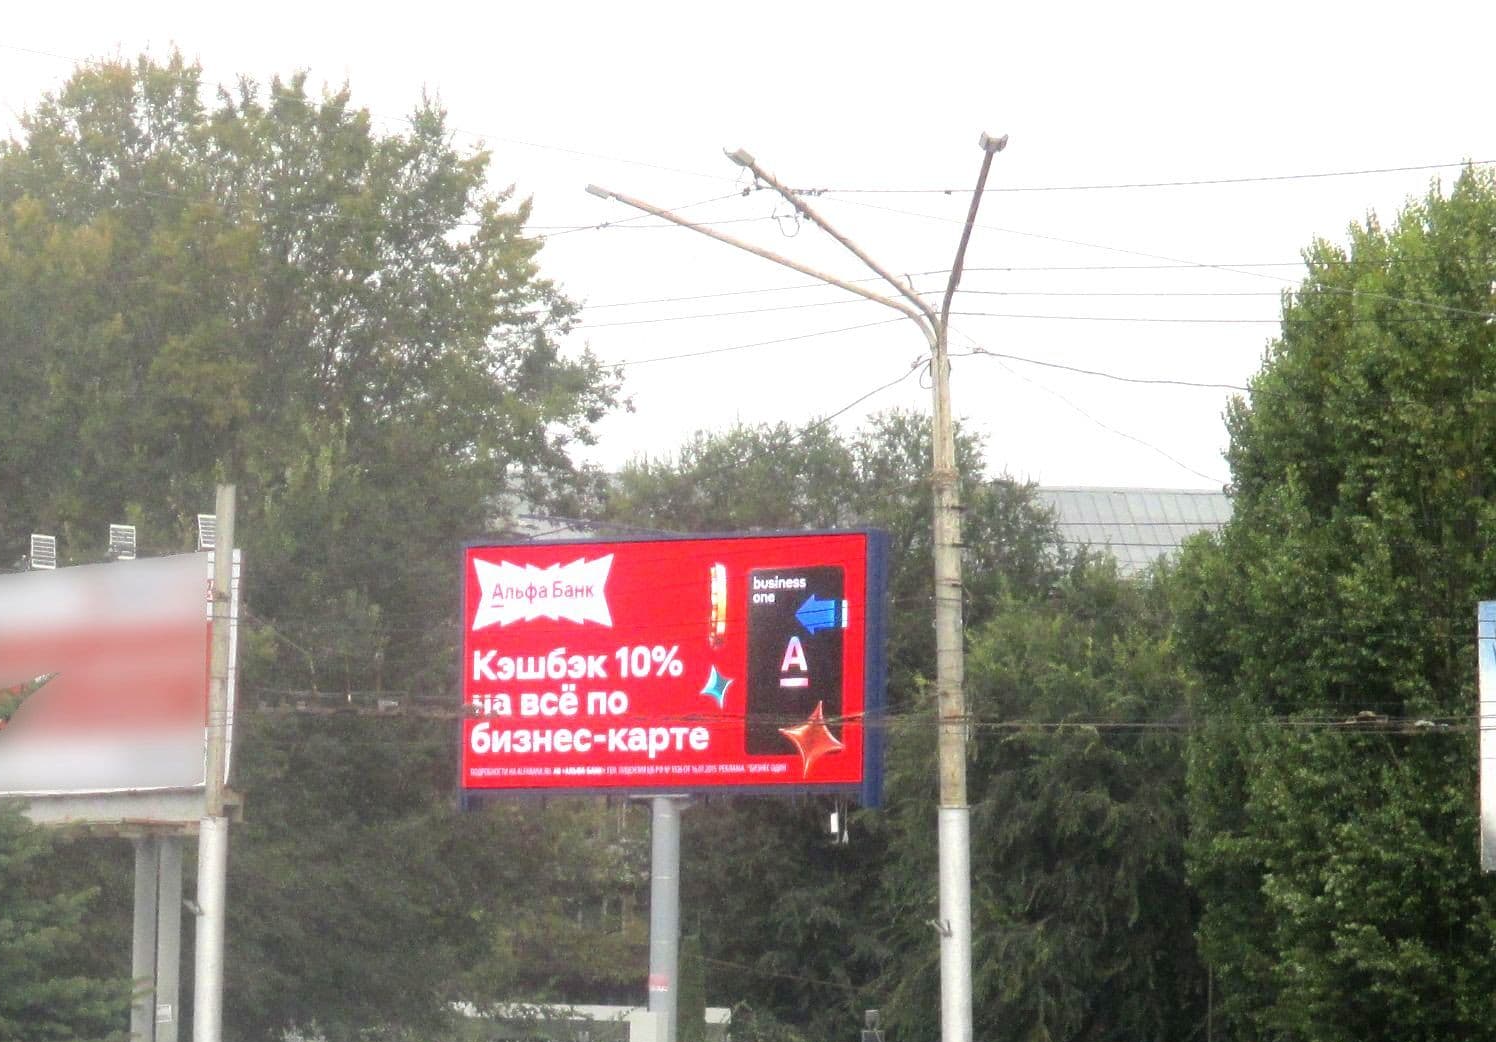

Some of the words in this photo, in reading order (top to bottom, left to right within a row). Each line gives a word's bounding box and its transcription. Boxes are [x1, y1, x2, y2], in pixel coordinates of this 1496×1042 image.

[491, 581, 547, 607] Альфа
[552, 580, 594, 598] Банк
[753, 576, 807, 590] business
[752, 593, 776, 604] one
[472, 648, 608, 681] Кэшбэк
[615, 645, 684, 678] 10%
[520, 683, 579, 717] всё
[587, 690, 629, 716] по
[470, 722, 710, 759] бизнес-карте
